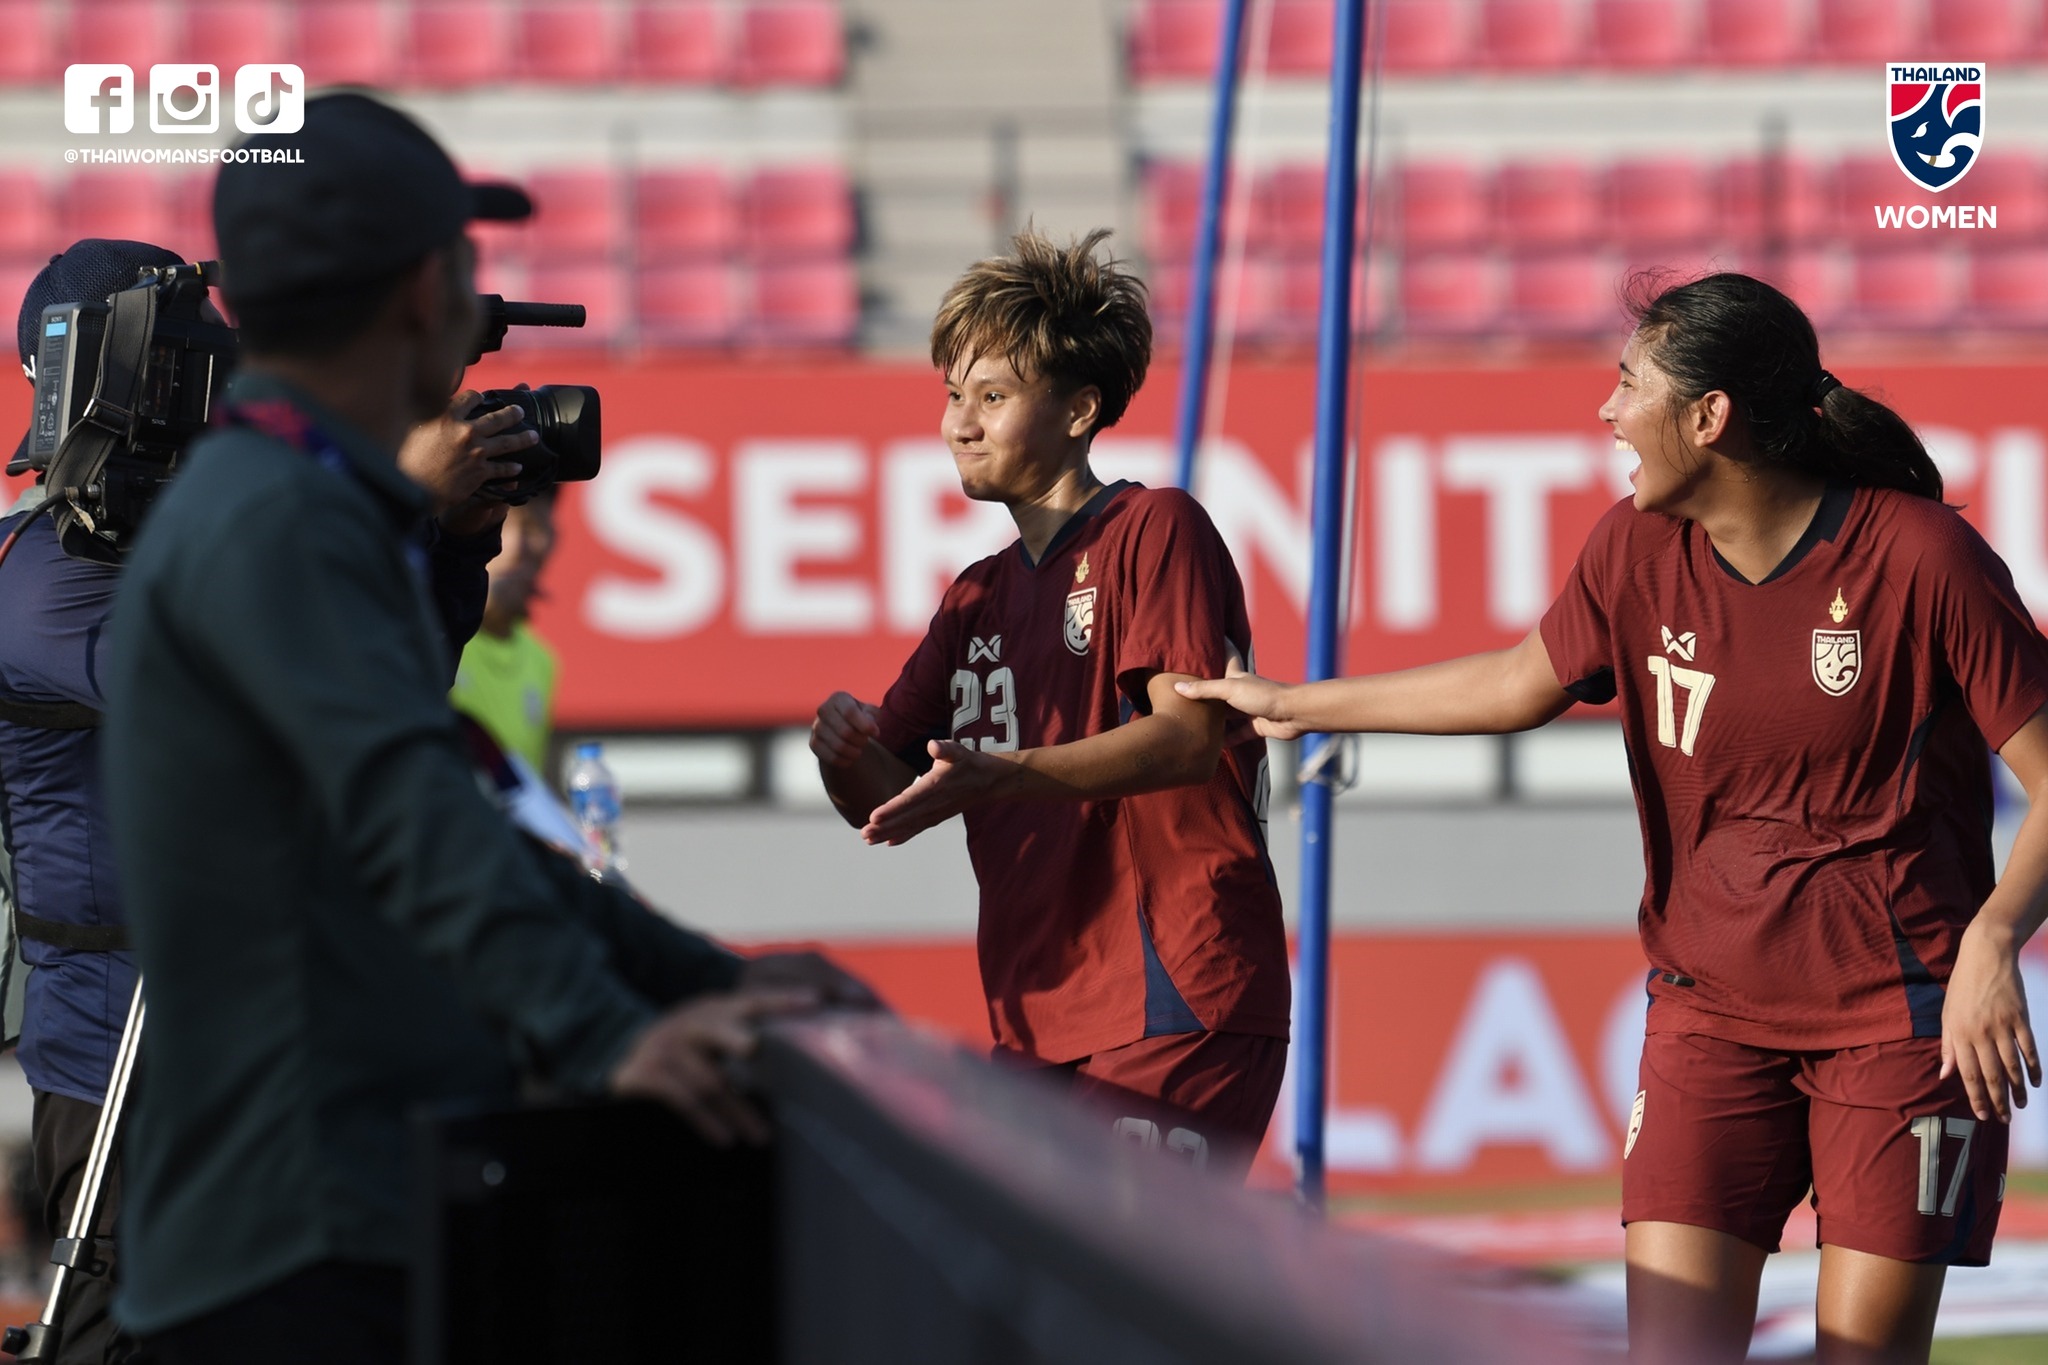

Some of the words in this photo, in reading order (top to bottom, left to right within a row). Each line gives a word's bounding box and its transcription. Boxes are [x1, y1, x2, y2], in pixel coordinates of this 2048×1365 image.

[584, 435, 1642, 637] SERNIT
[1816, 635, 1855, 644] THAILAND
[950, 666, 1019, 753] 23
[1647, 655, 1716, 757] 17
[1910, 1116, 1976, 1217] 17
